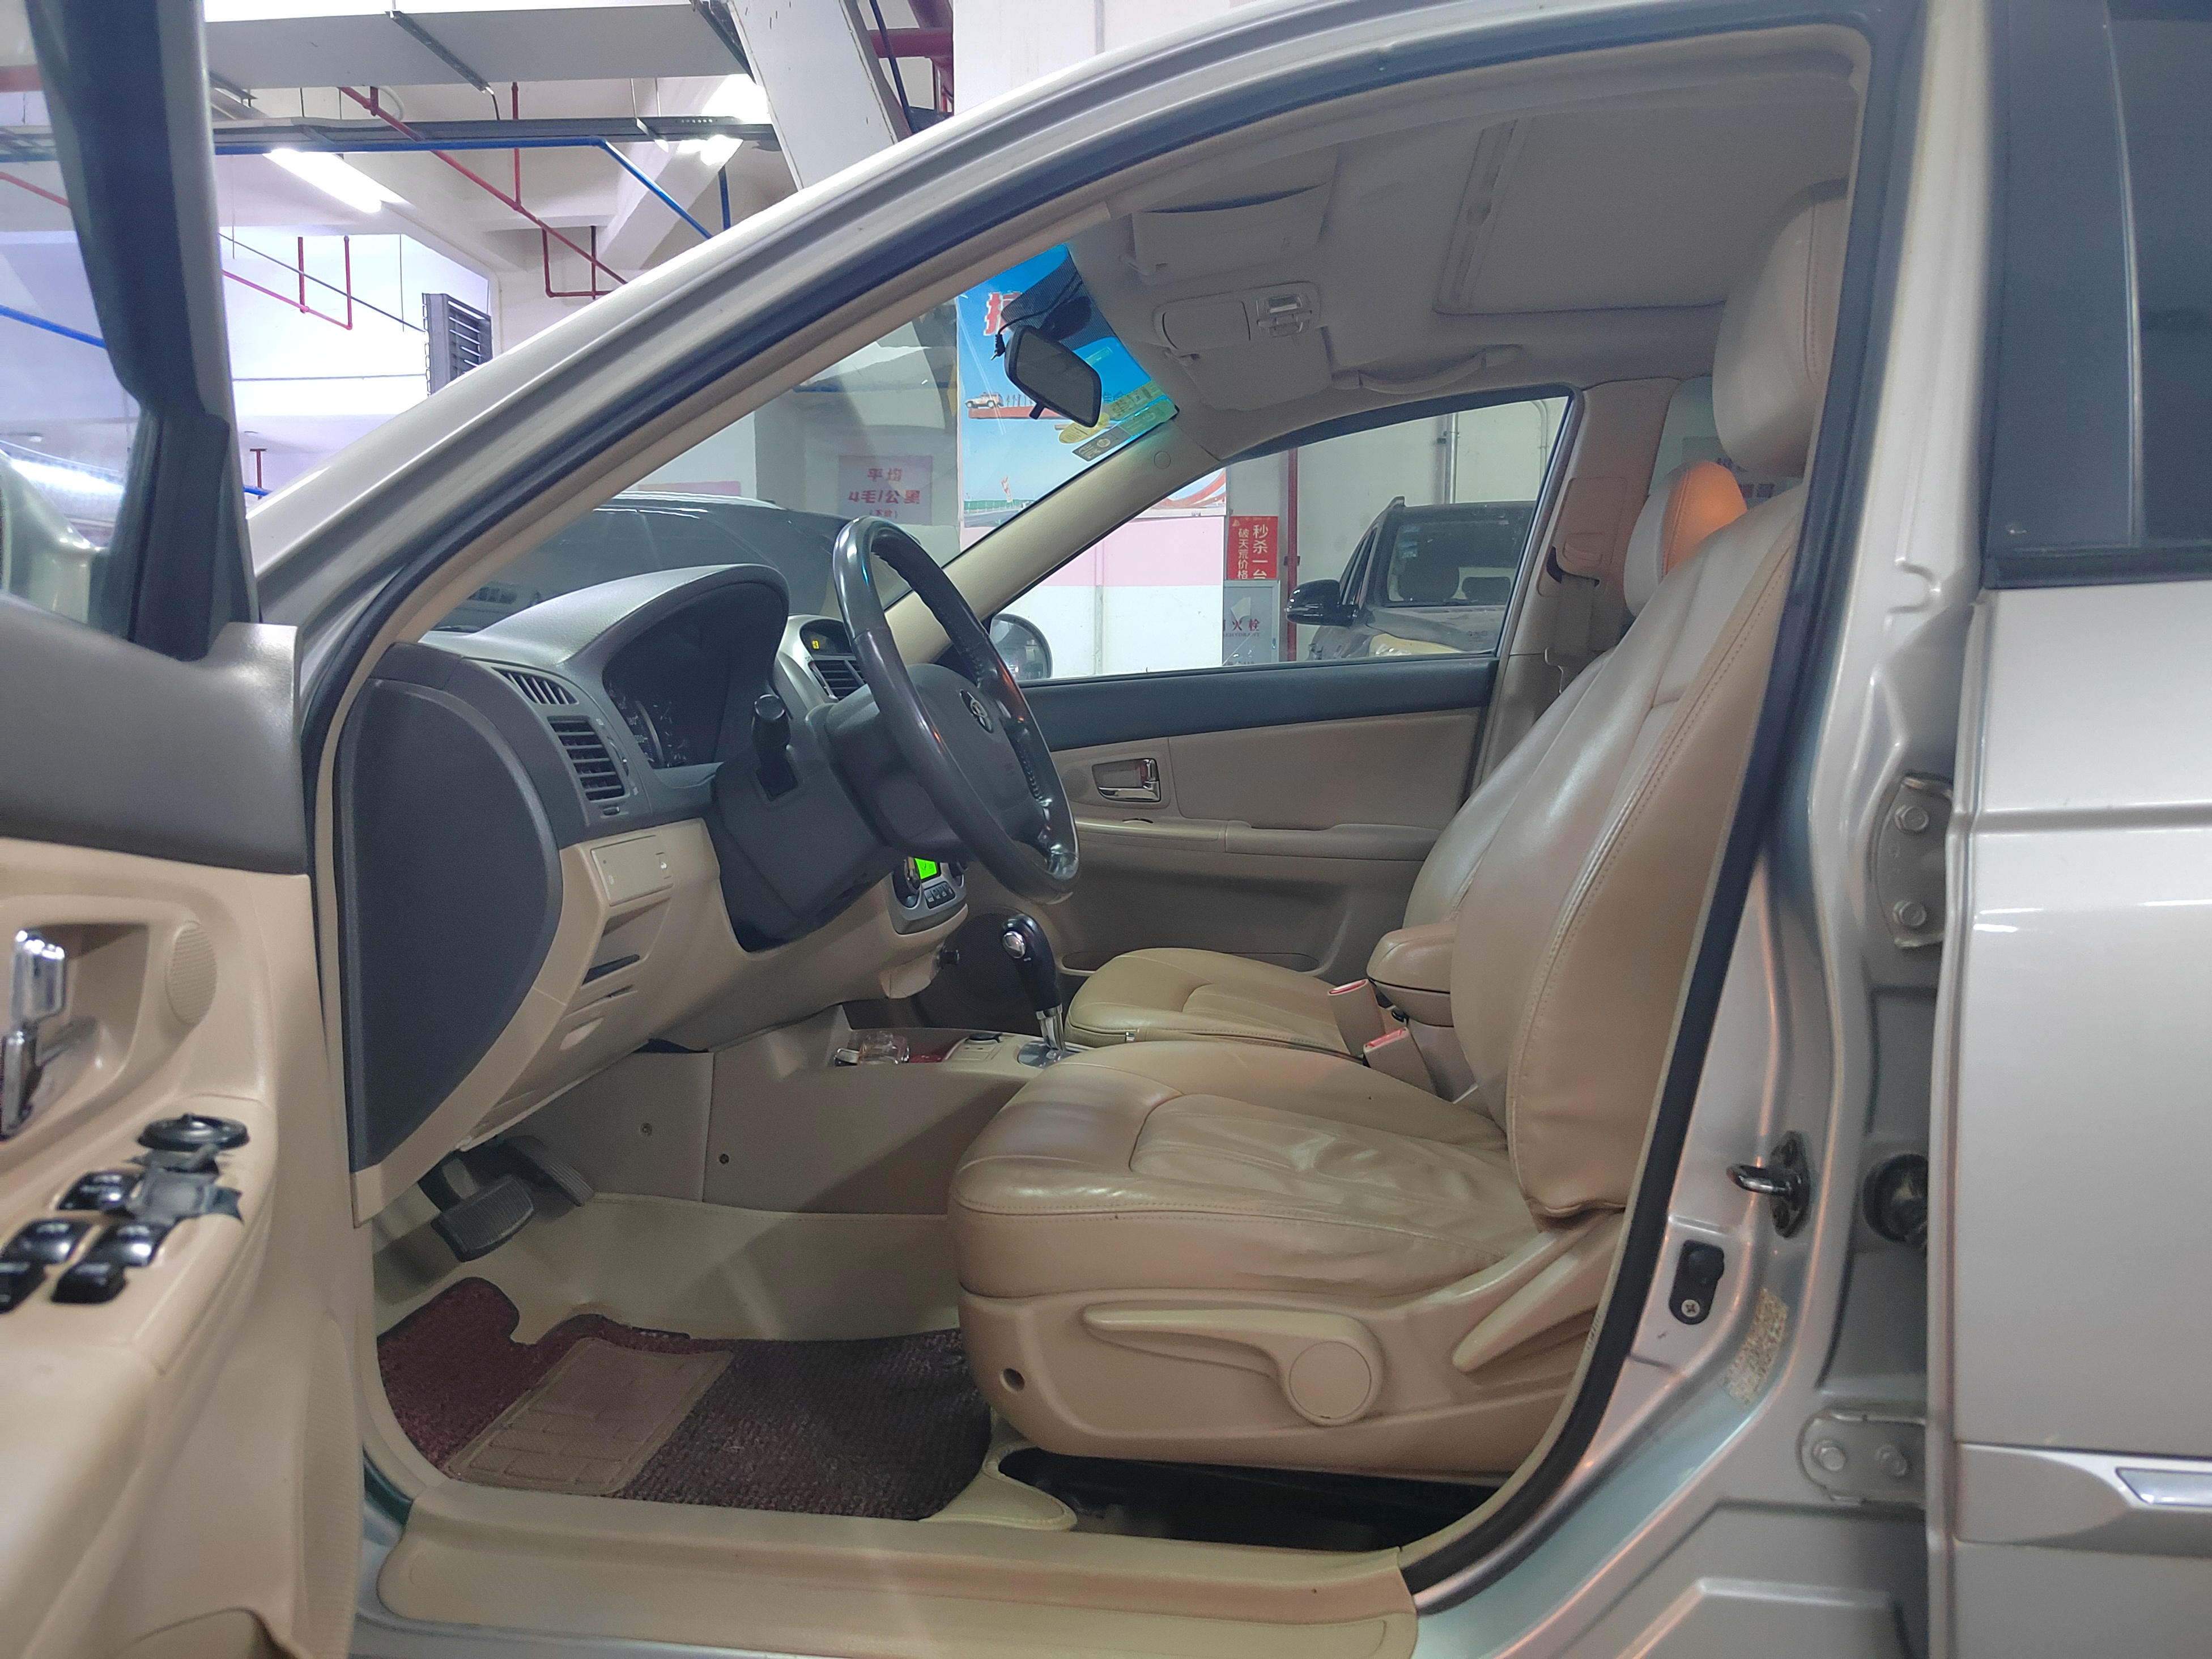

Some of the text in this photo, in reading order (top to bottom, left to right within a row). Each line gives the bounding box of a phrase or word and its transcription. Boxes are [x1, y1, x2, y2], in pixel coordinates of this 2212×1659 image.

[1237, 528, 1249, 579] 破天荒价格
[1223, 618, 1260, 632] 火栓
